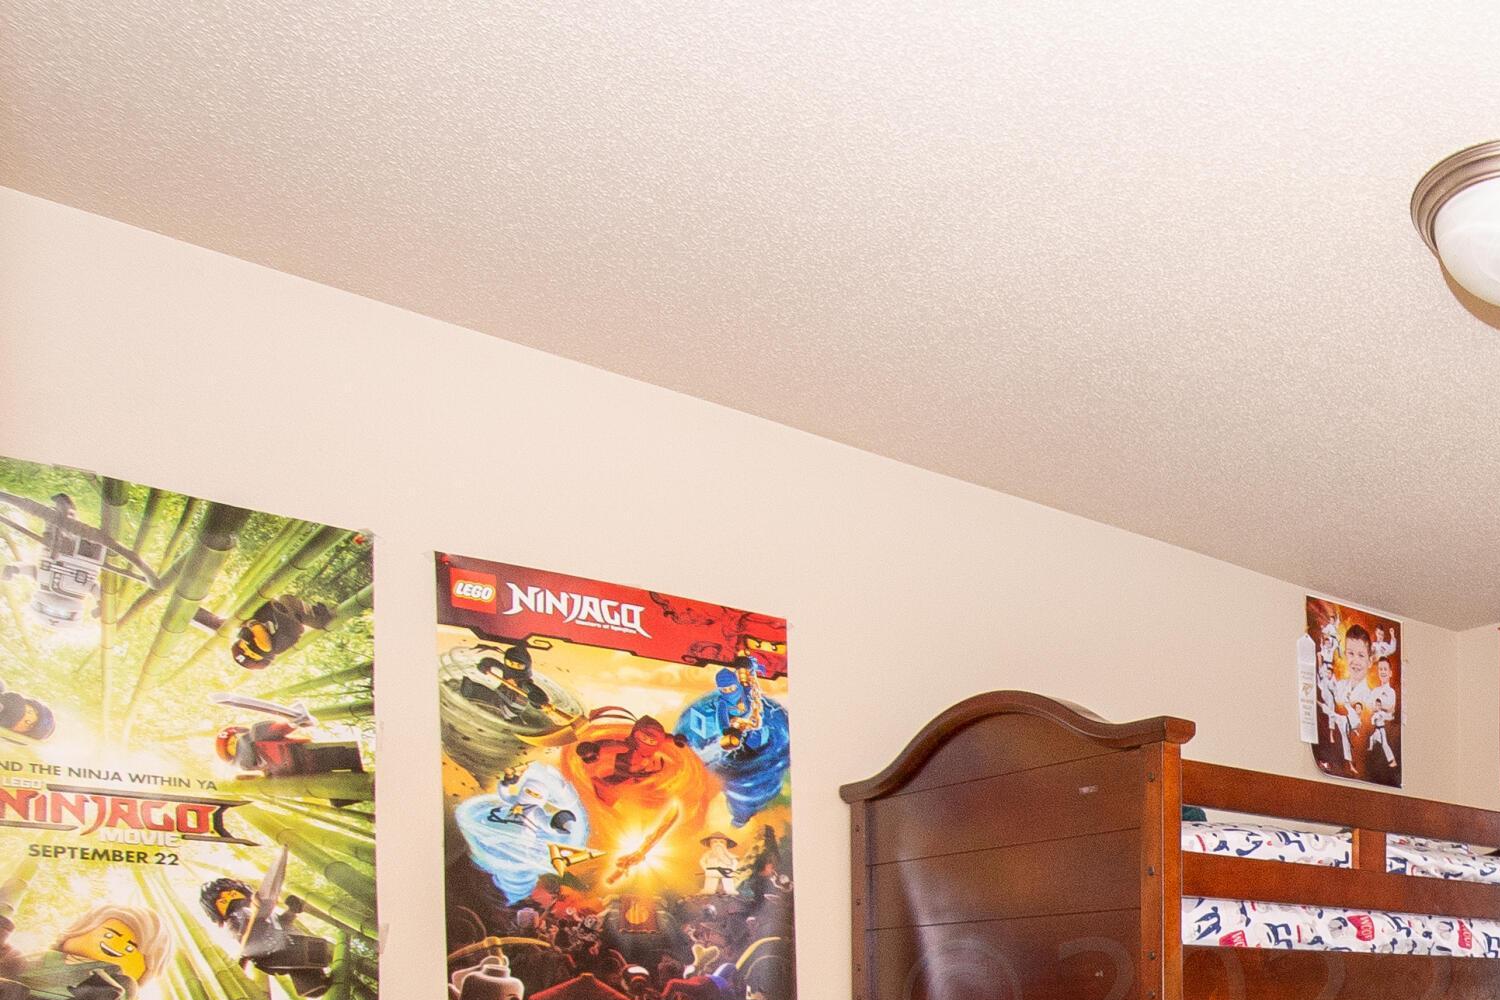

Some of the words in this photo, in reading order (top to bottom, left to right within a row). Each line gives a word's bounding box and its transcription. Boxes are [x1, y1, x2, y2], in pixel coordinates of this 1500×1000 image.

[455, 581, 494, 601] LEGO
[502, 582, 653, 640] NINJAGO
[29, 762, 61, 776] THE
[68, 767, 123, 782] NINJA
[128, 773, 191, 788] WITHIN
[197, 779, 218, 791] YA
[0, 788, 219, 836] NINJAGO
[99, 829, 181, 848] MOVIE
[28, 844, 148, 865] SEPTEMBER
[154, 852, 180, 866] 22
